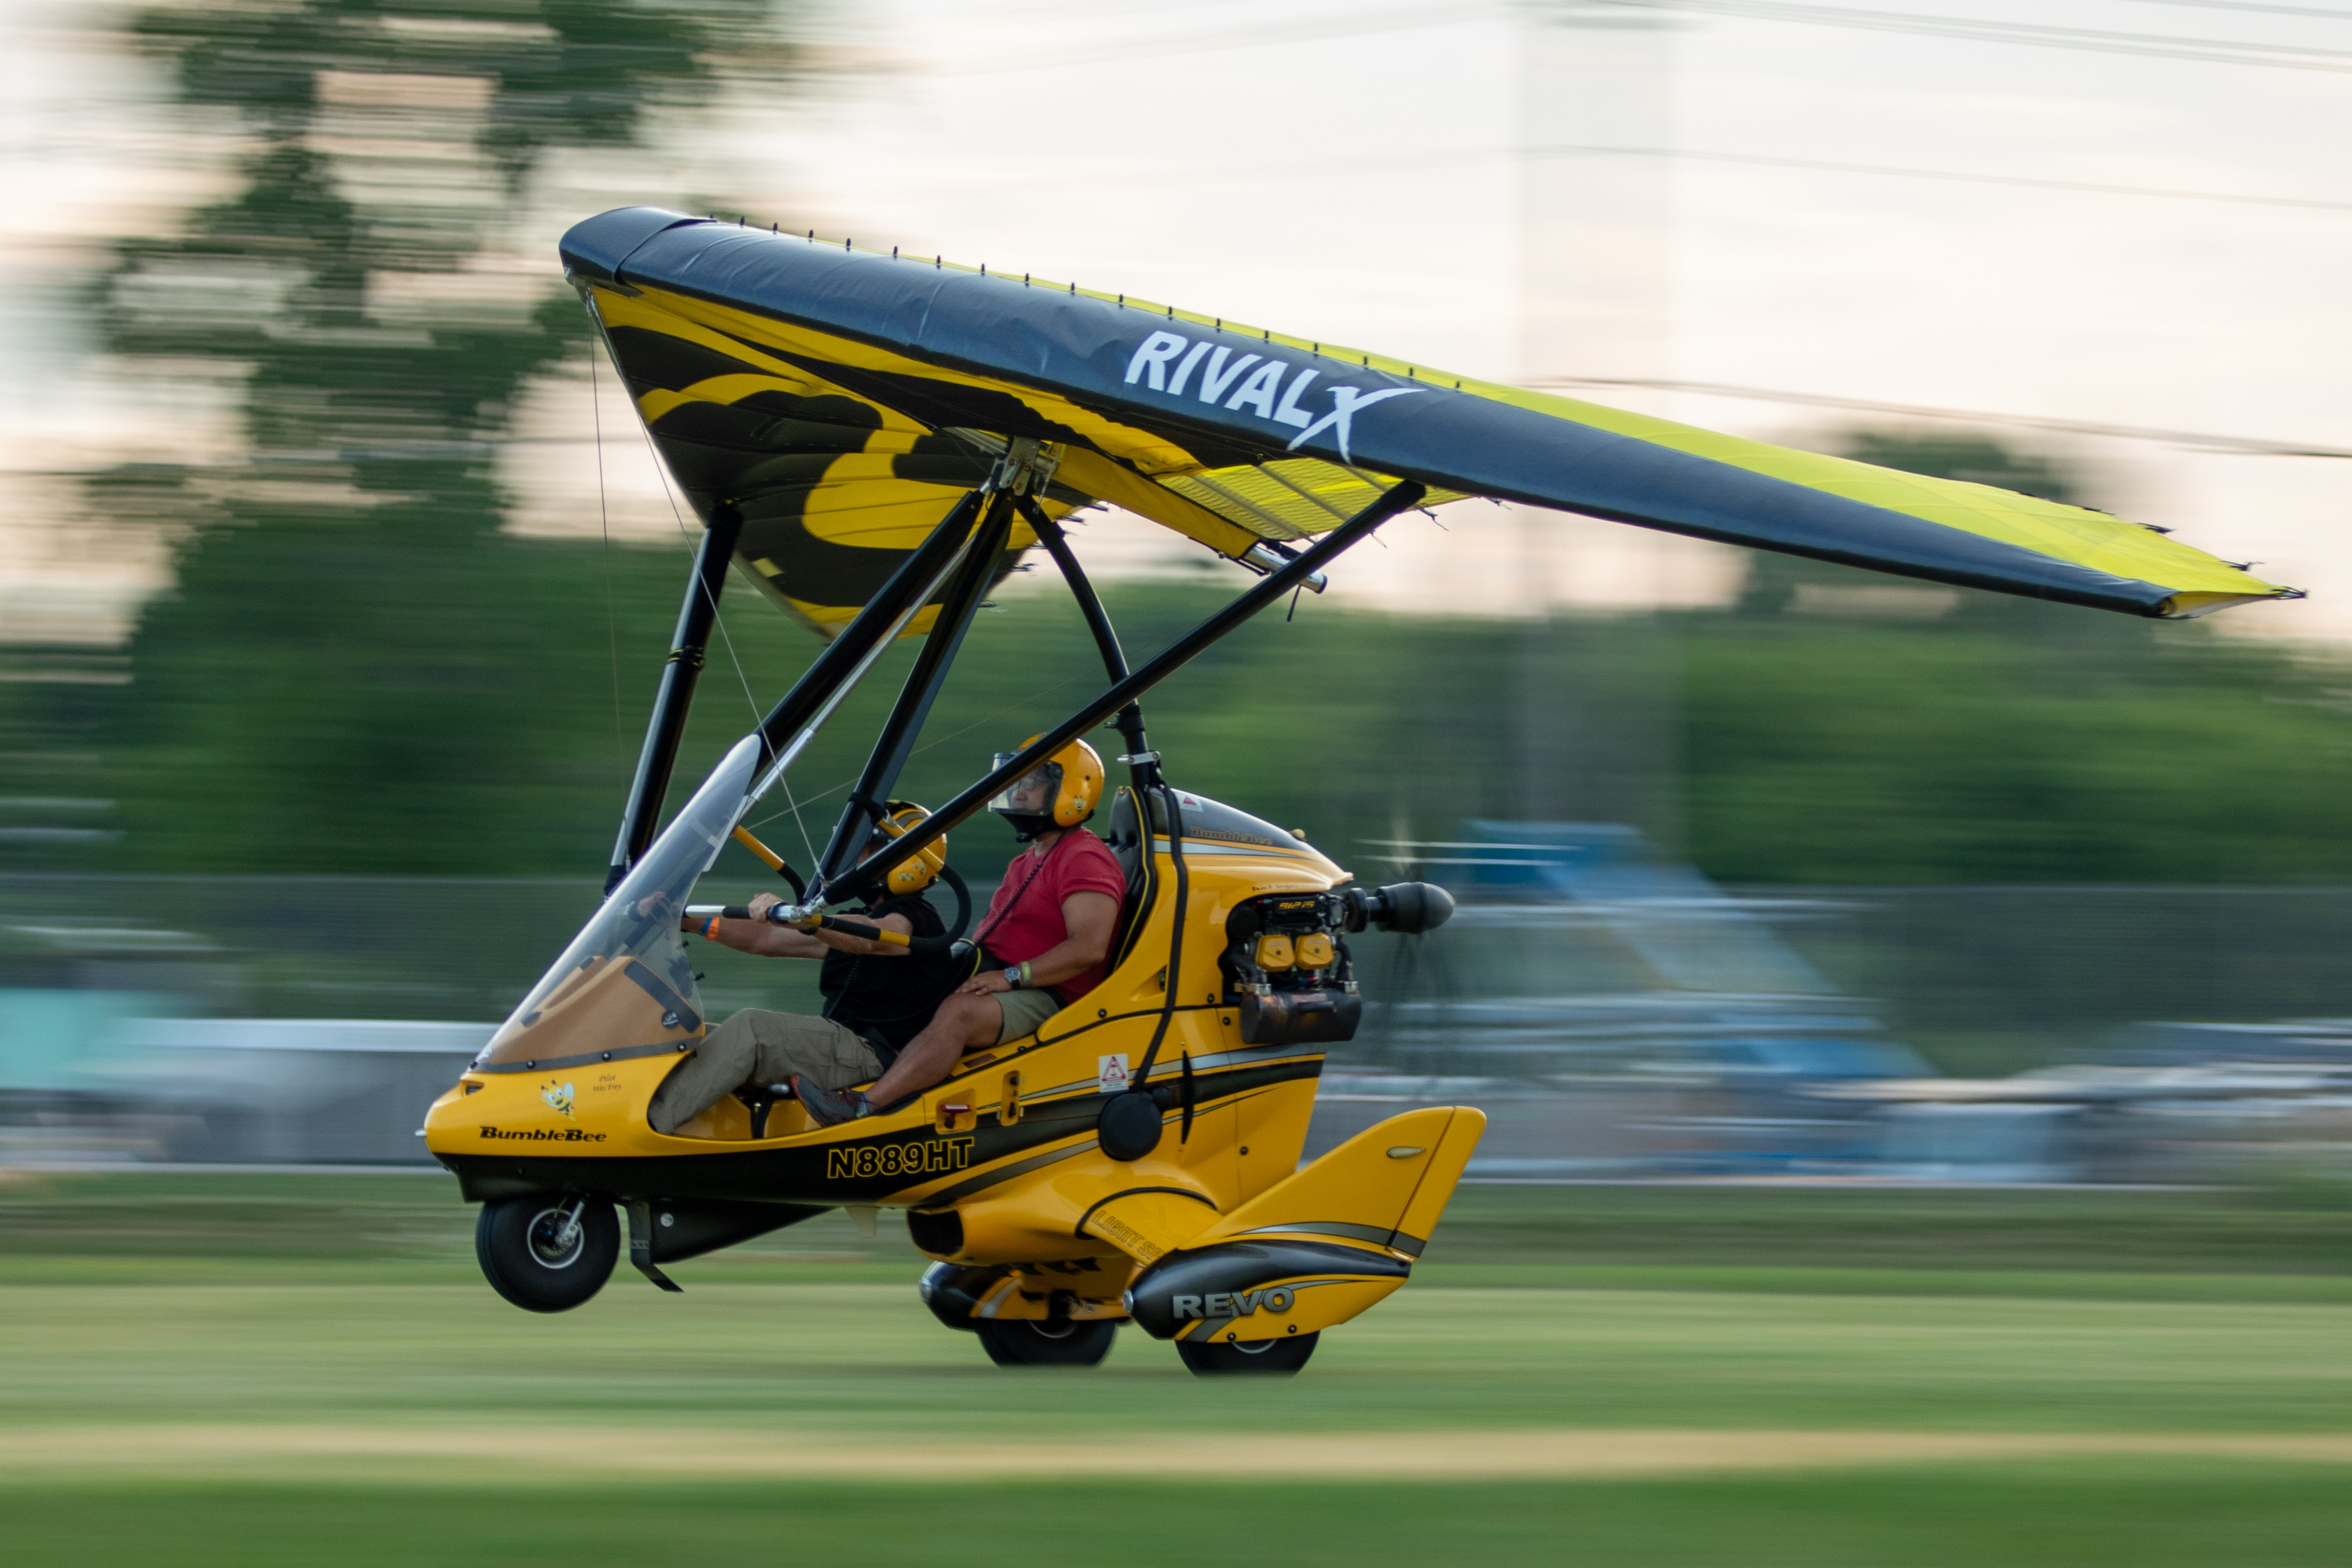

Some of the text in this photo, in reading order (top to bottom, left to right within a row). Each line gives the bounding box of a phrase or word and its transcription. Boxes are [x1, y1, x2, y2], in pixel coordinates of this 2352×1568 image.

[480, 1125, 606, 1141] BumbleBee
[827, 1136, 975, 1179] N889HT
[1092, 1209, 1145, 1248] LIGHT
[1173, 1287, 1294, 1318] REVO
